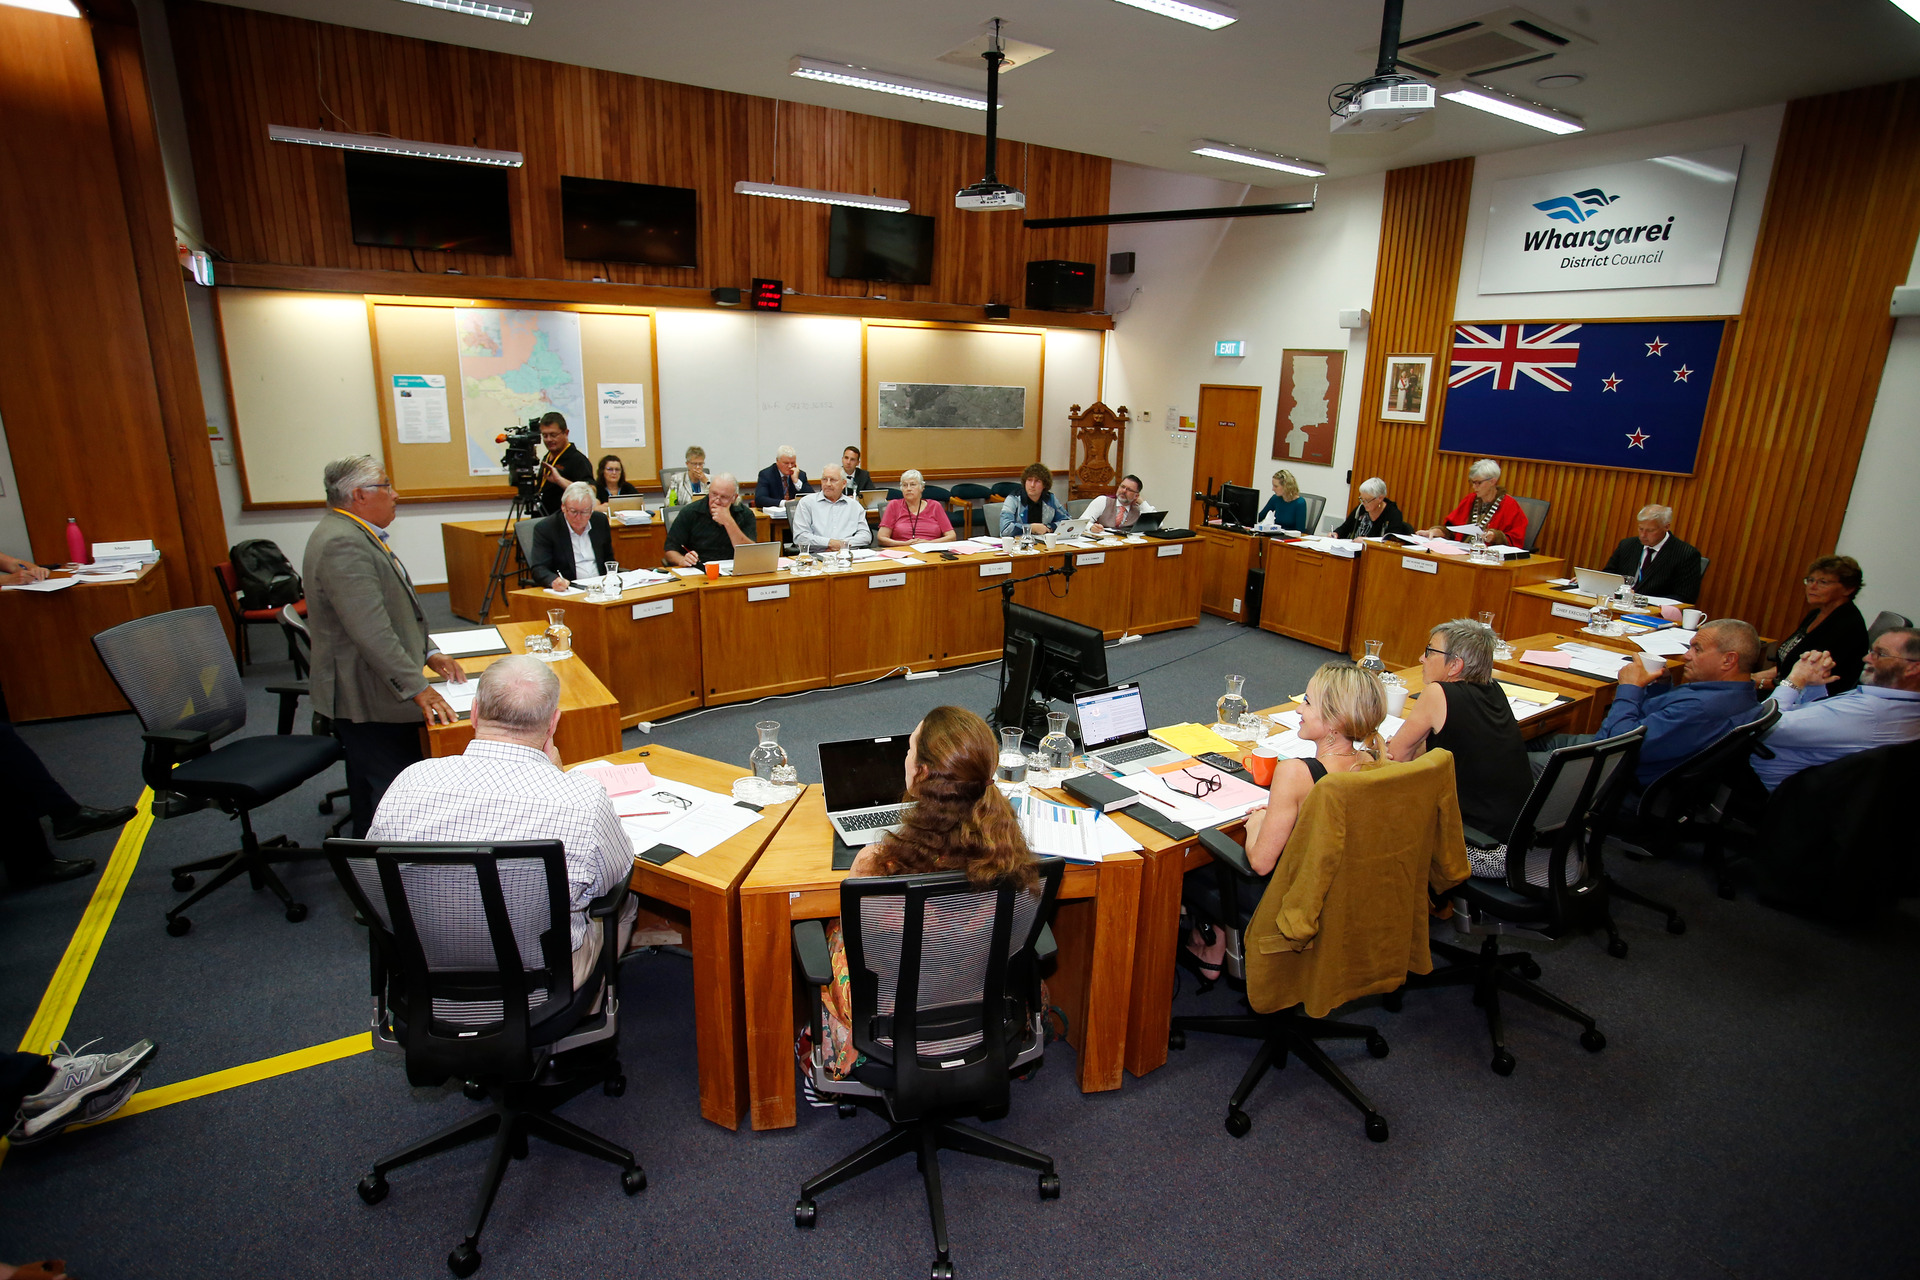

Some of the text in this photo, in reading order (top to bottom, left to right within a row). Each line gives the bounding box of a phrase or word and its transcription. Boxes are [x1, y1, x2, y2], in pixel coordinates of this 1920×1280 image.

[1523, 216, 1675, 252] Whangarei
[1560, 250, 1664, 269] District Council
[1220, 343, 1236, 354] EXIT
